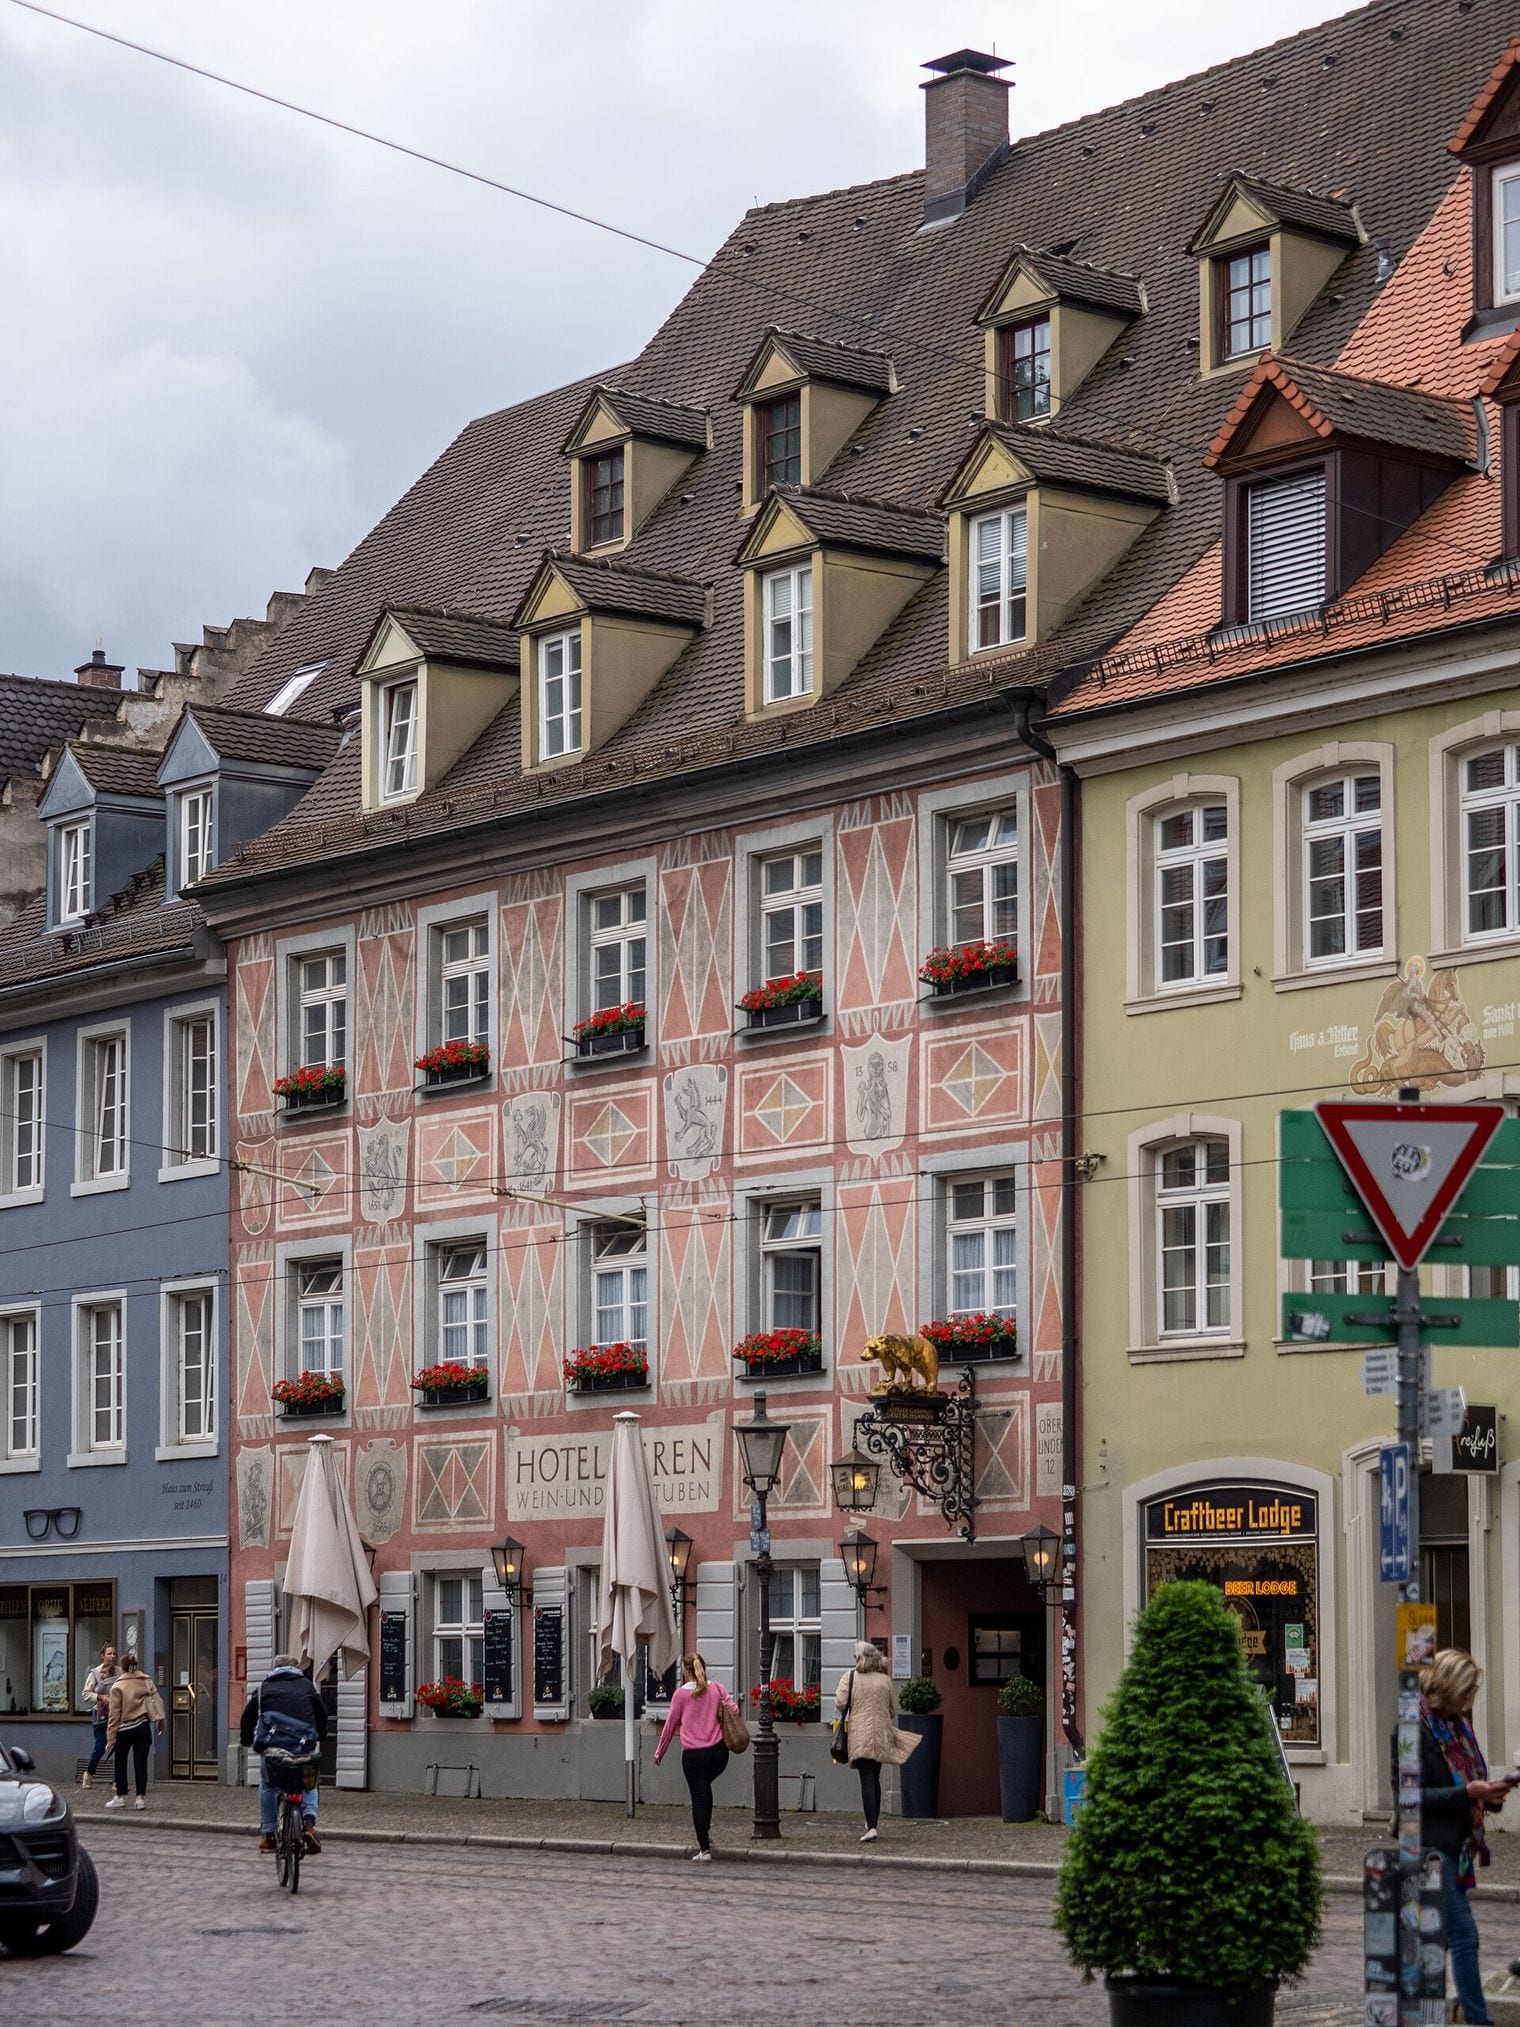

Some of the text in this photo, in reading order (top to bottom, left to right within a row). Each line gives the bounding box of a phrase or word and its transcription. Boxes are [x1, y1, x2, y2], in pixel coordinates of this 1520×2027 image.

[516, 1438, 712, 1484] HOTEL REN
[1045, 1459, 1056, 1475] 12
[162, 1483, 179, 1494] Haus
[179, 1485, 192, 1493] zum
[1395, 1456, 1407, 1526] P
[1164, 1498, 1301, 1535] Craftbeer Lodge
[1225, 1581, 1297, 1596] BEER LODGE
